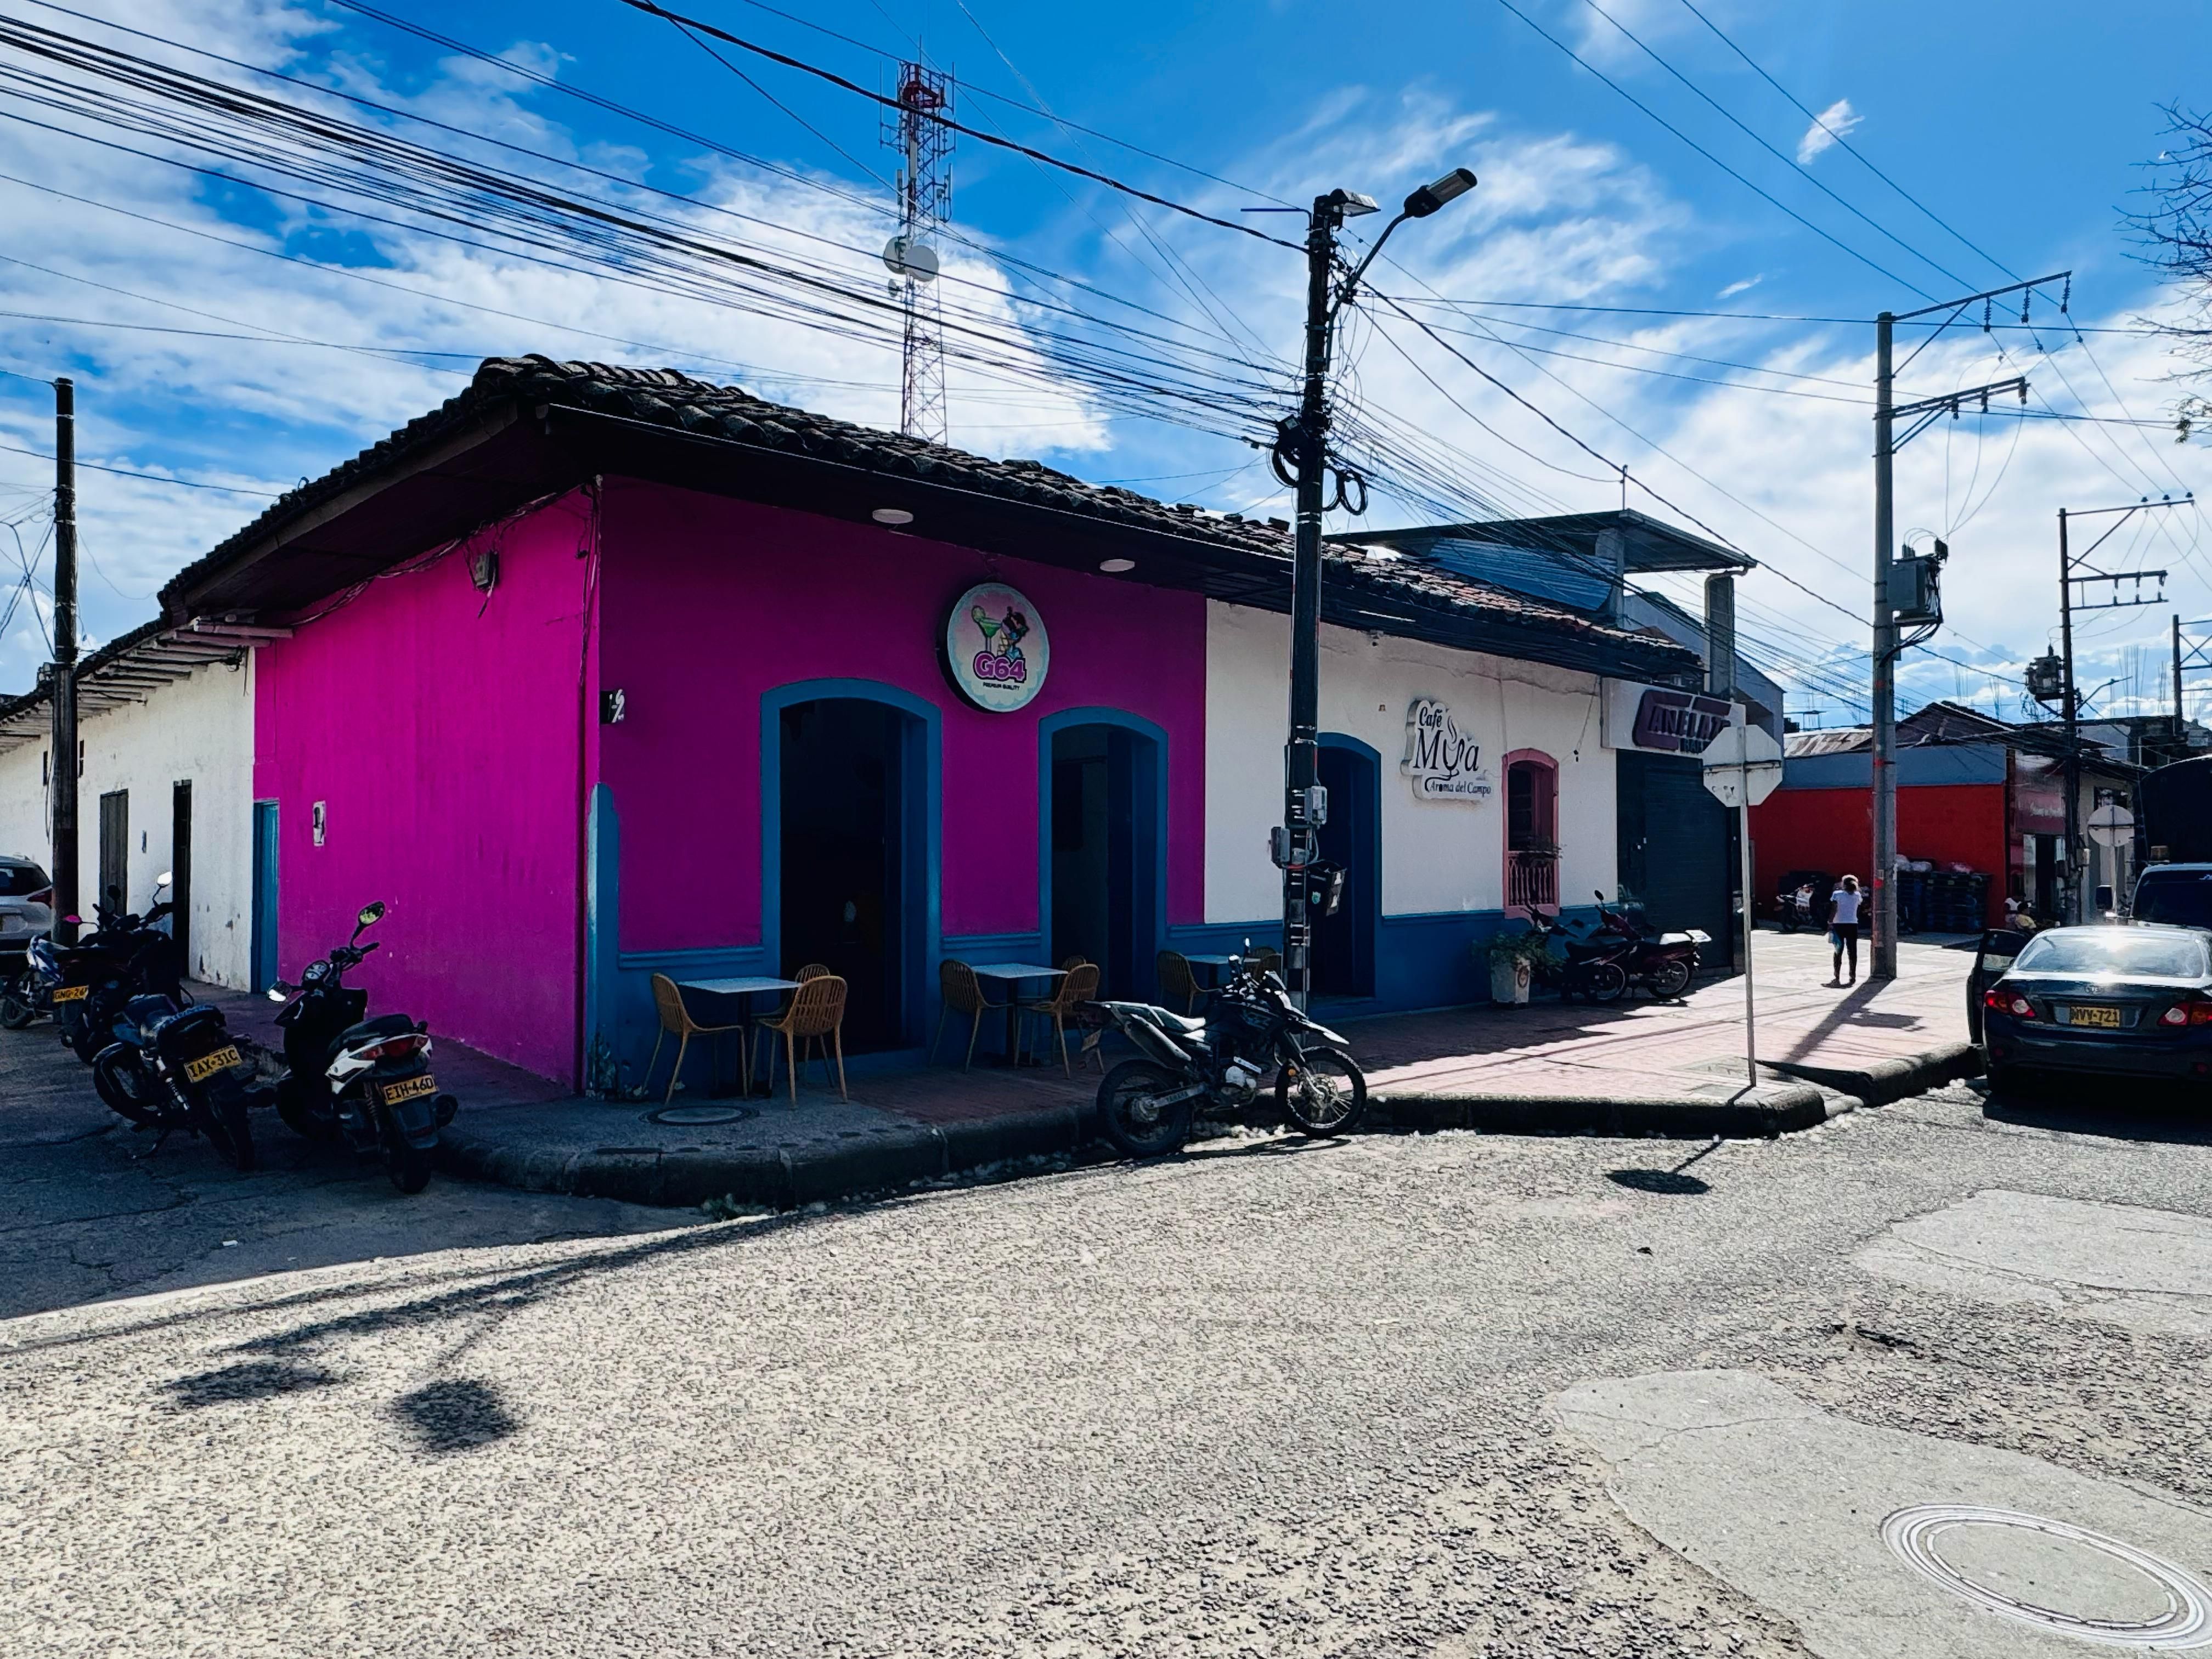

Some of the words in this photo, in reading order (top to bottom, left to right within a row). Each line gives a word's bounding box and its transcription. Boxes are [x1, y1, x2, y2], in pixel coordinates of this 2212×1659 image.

[973, 651, 1027, 683] G64
[1419, 707, 1443, 731] Café
[1430, 781, 1454, 792] Aroma
[1455, 781, 1466, 793] del
[1468, 782, 1491, 797] Campo
